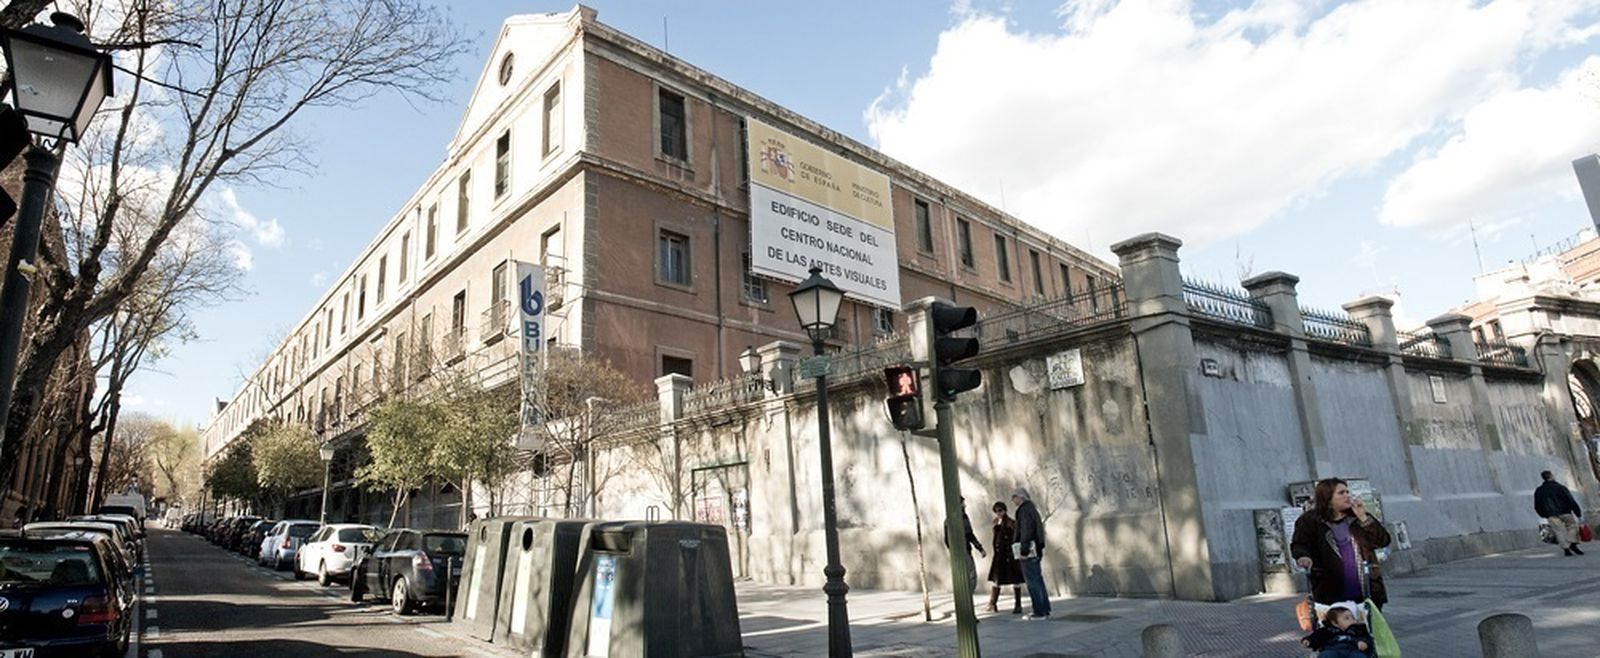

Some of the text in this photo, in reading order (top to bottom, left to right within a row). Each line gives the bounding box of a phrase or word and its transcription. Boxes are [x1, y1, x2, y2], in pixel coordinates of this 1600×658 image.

[770, 201, 879, 248] EDIFICIO SEDE DEL
[780, 227, 874, 266] CENTRO NACIONAL
[767, 246, 784, 261] DE
[786, 251, 808, 267] LAS
[844, 269, 888, 291] VISUALES
